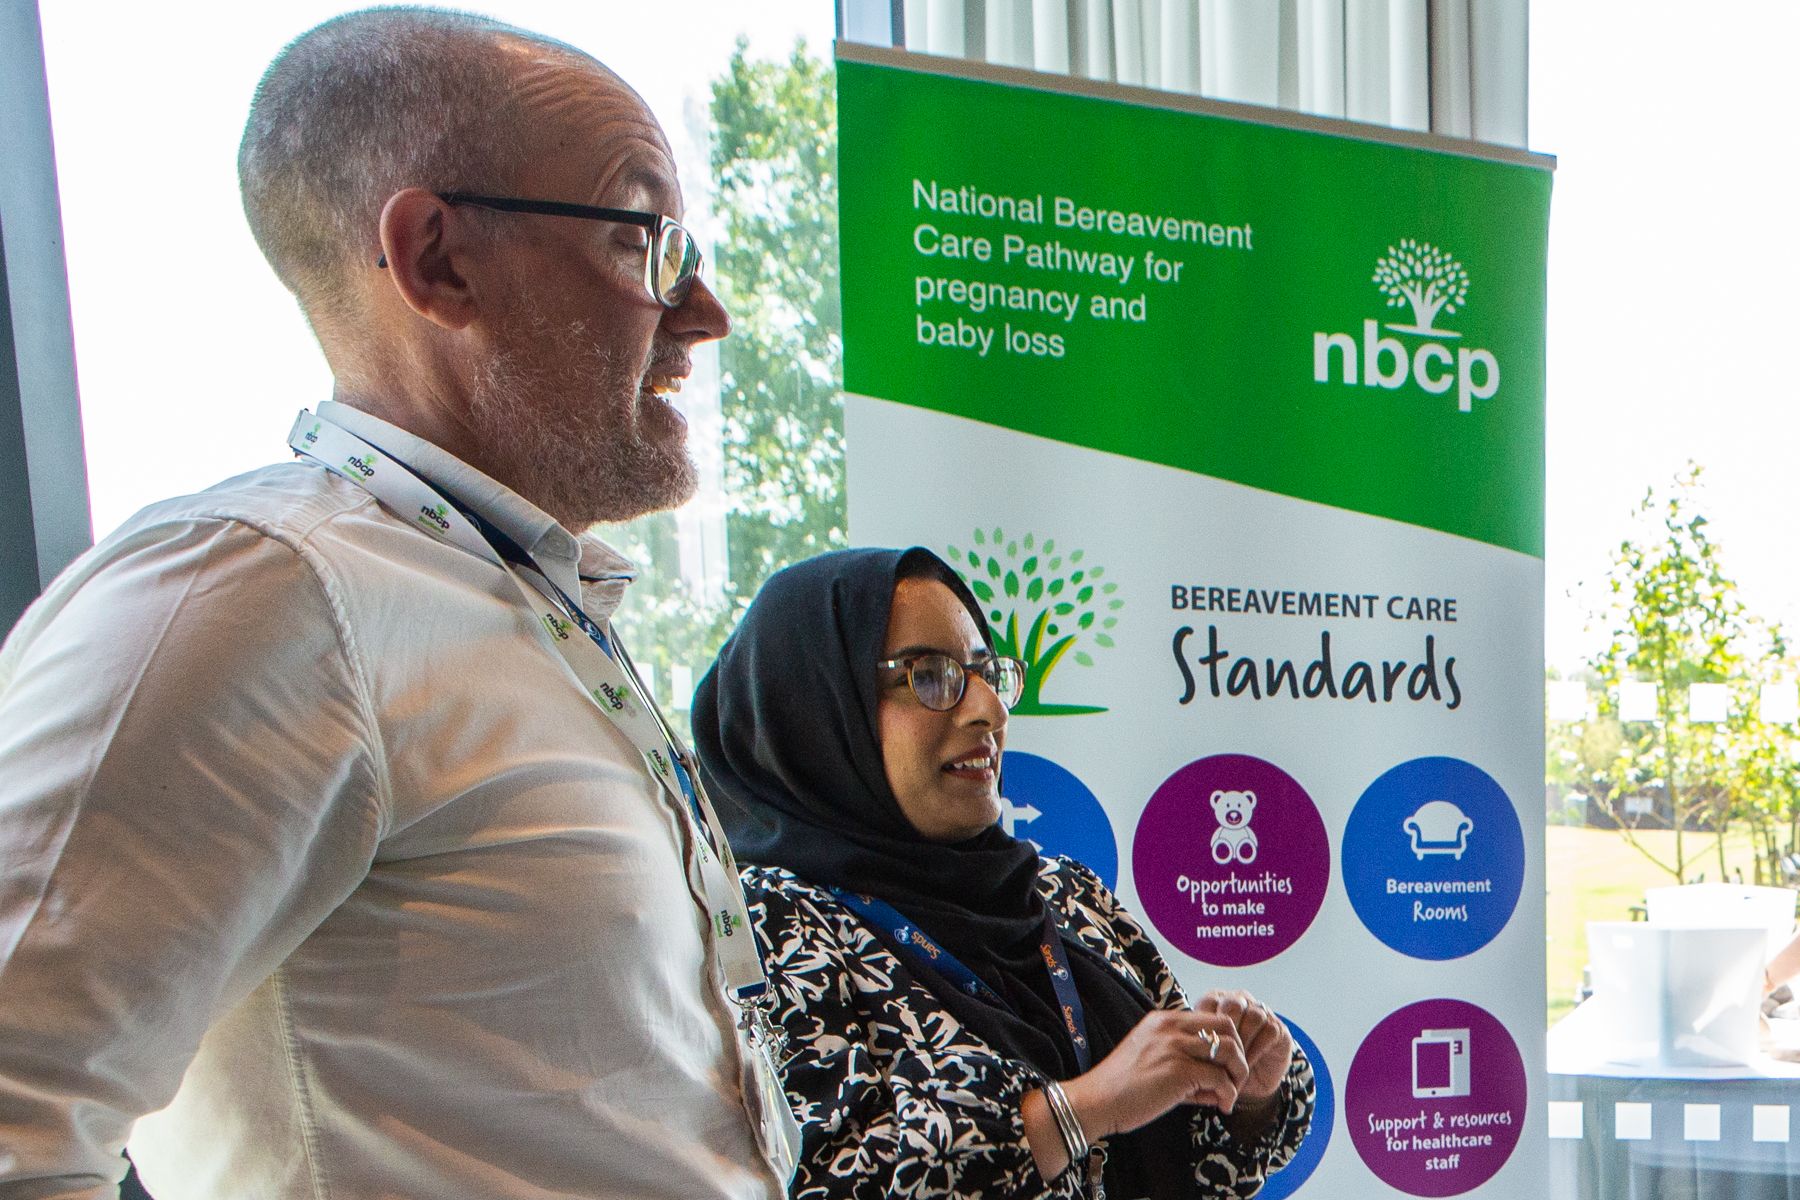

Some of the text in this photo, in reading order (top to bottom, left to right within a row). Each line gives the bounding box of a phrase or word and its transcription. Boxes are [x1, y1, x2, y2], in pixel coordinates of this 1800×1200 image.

[913, 179, 1253, 249] National Bereavement
[914, 224, 1184, 284] Care Pathway for
[915, 275, 1147, 322] pregnancy and
[917, 314, 1065, 357] baby loss
[1314, 320, 1500, 412] nbcp
[347, 455, 375, 478] nbcp
[420, 505, 450, 529] nbcp
[1171, 584, 1457, 622] BEREAVEMENT CARE
[546, 613, 569, 640] nbcp
[1172, 624, 1461, 710] Standards
[600, 682, 624, 710] nbcp
[652, 749, 669, 777] nbcp
[1177, 871, 1292, 903] Opportunities
[1386, 878, 1492, 894] Bereavement
[1202, 899, 1265, 916] to make
[1414, 900, 1468, 922] Rooms
[721, 909, 733, 938] nbcp
[1197, 921, 1275, 938] memories
[910, 931, 941, 959] Sands
[1040, 944, 1057, 969] Sands
[1062, 1005, 1078, 1034] Sands
[1368, 1110, 1512, 1138] Support & resources
[1386, 1134, 1492, 1151] for healthcare
[1426, 1154, 1460, 1170] staff
